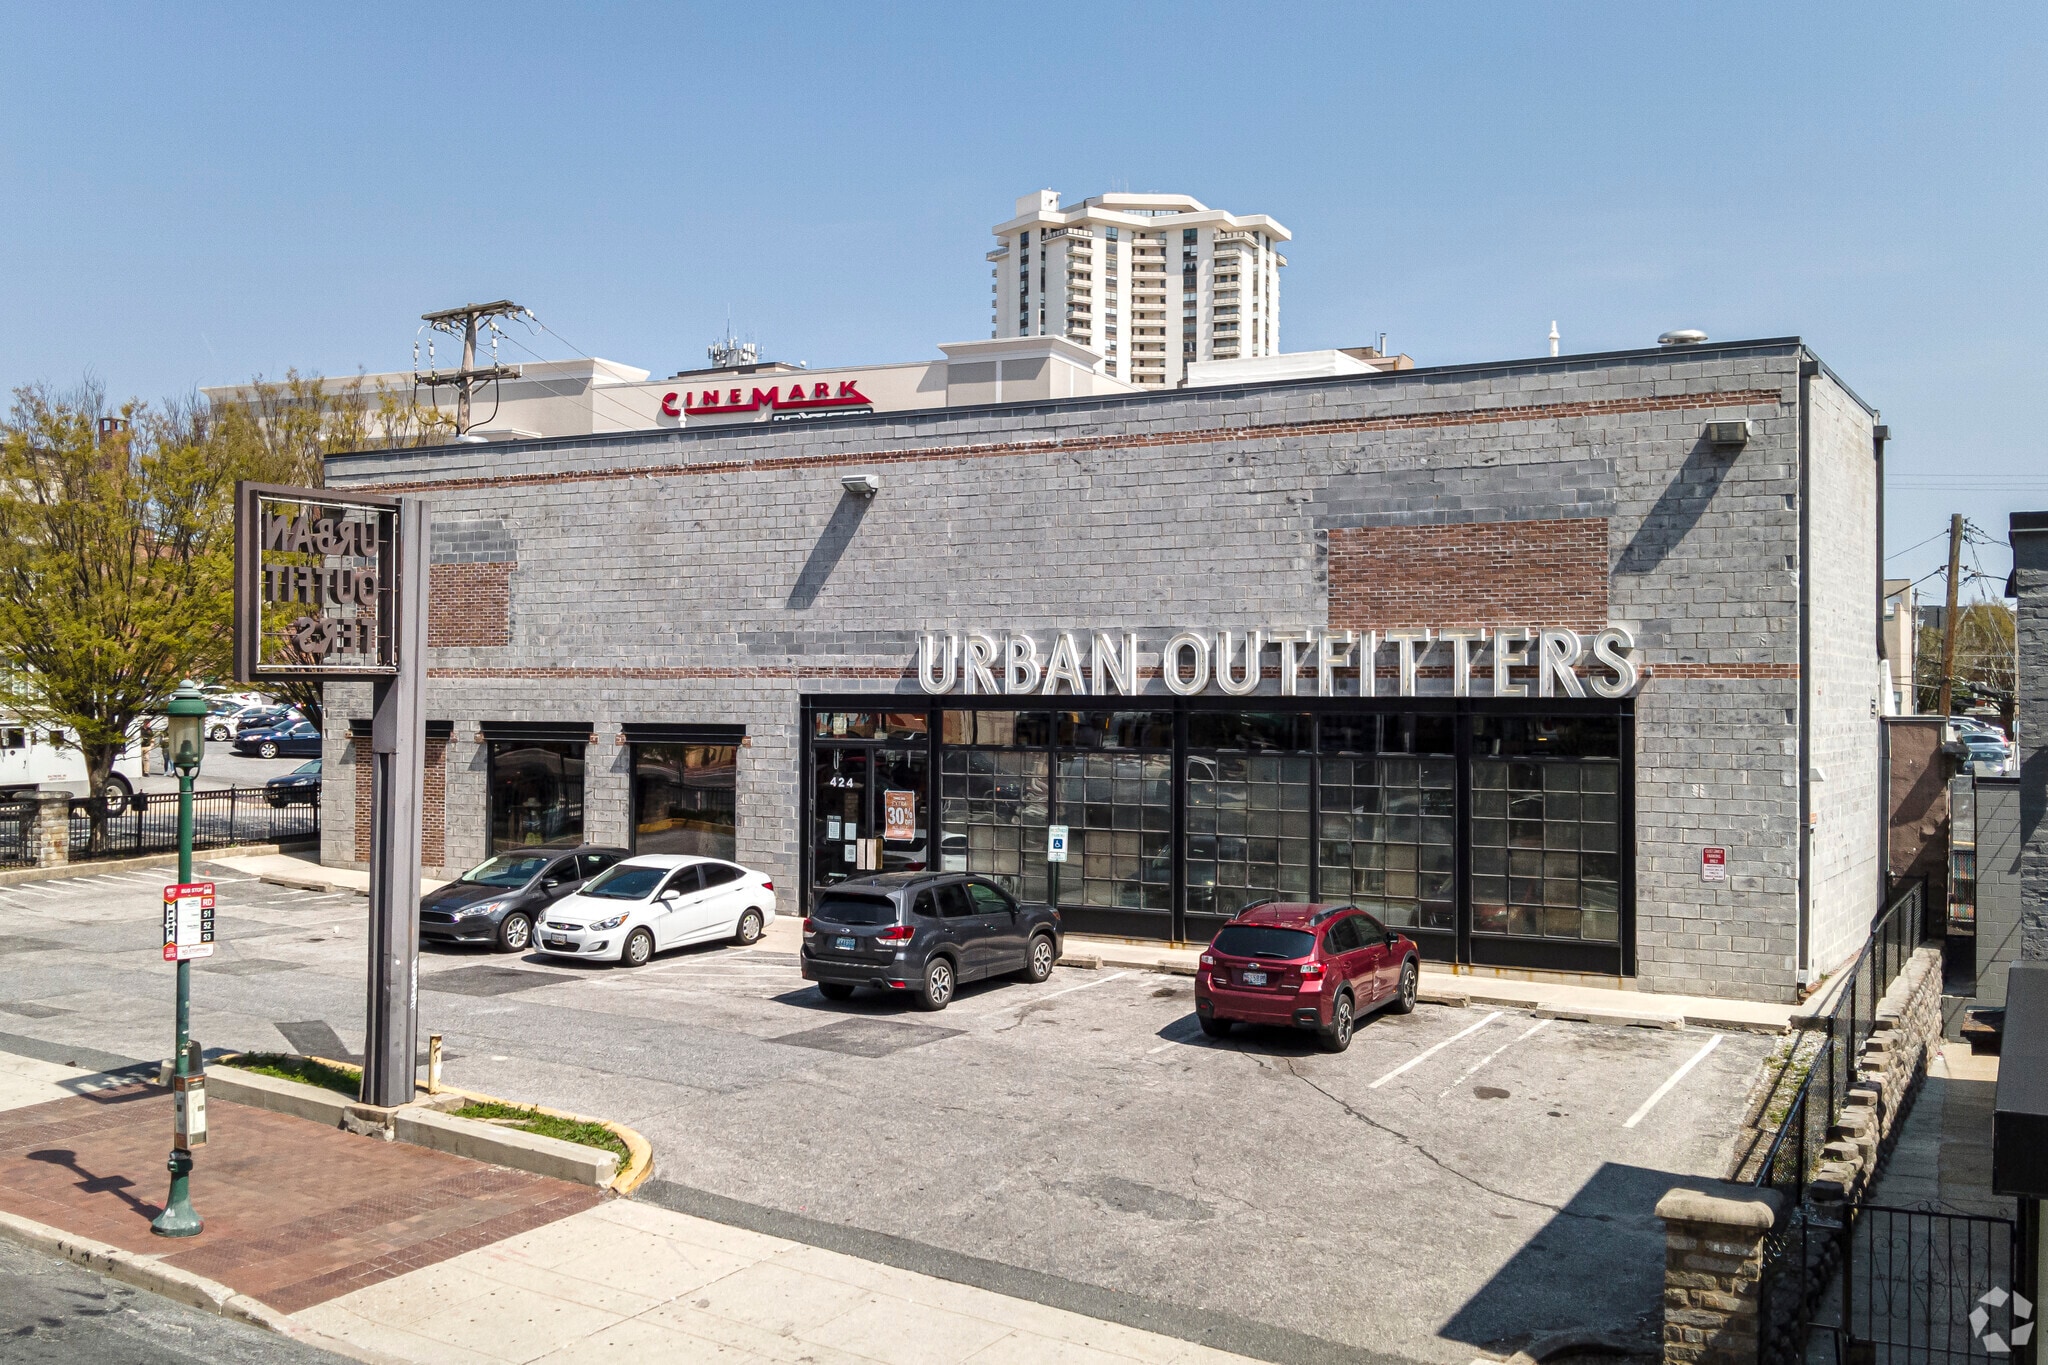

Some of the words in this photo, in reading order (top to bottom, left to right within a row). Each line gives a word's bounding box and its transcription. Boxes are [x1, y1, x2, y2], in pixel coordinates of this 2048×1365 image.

[662, 379, 873, 417] CINEMARK
[918, 632, 1138, 696] URBAN
[1163, 627, 1636, 698] OUTFITTERS
[830, 777, 853, 787] 424
[887, 807, 912, 824] 30%
